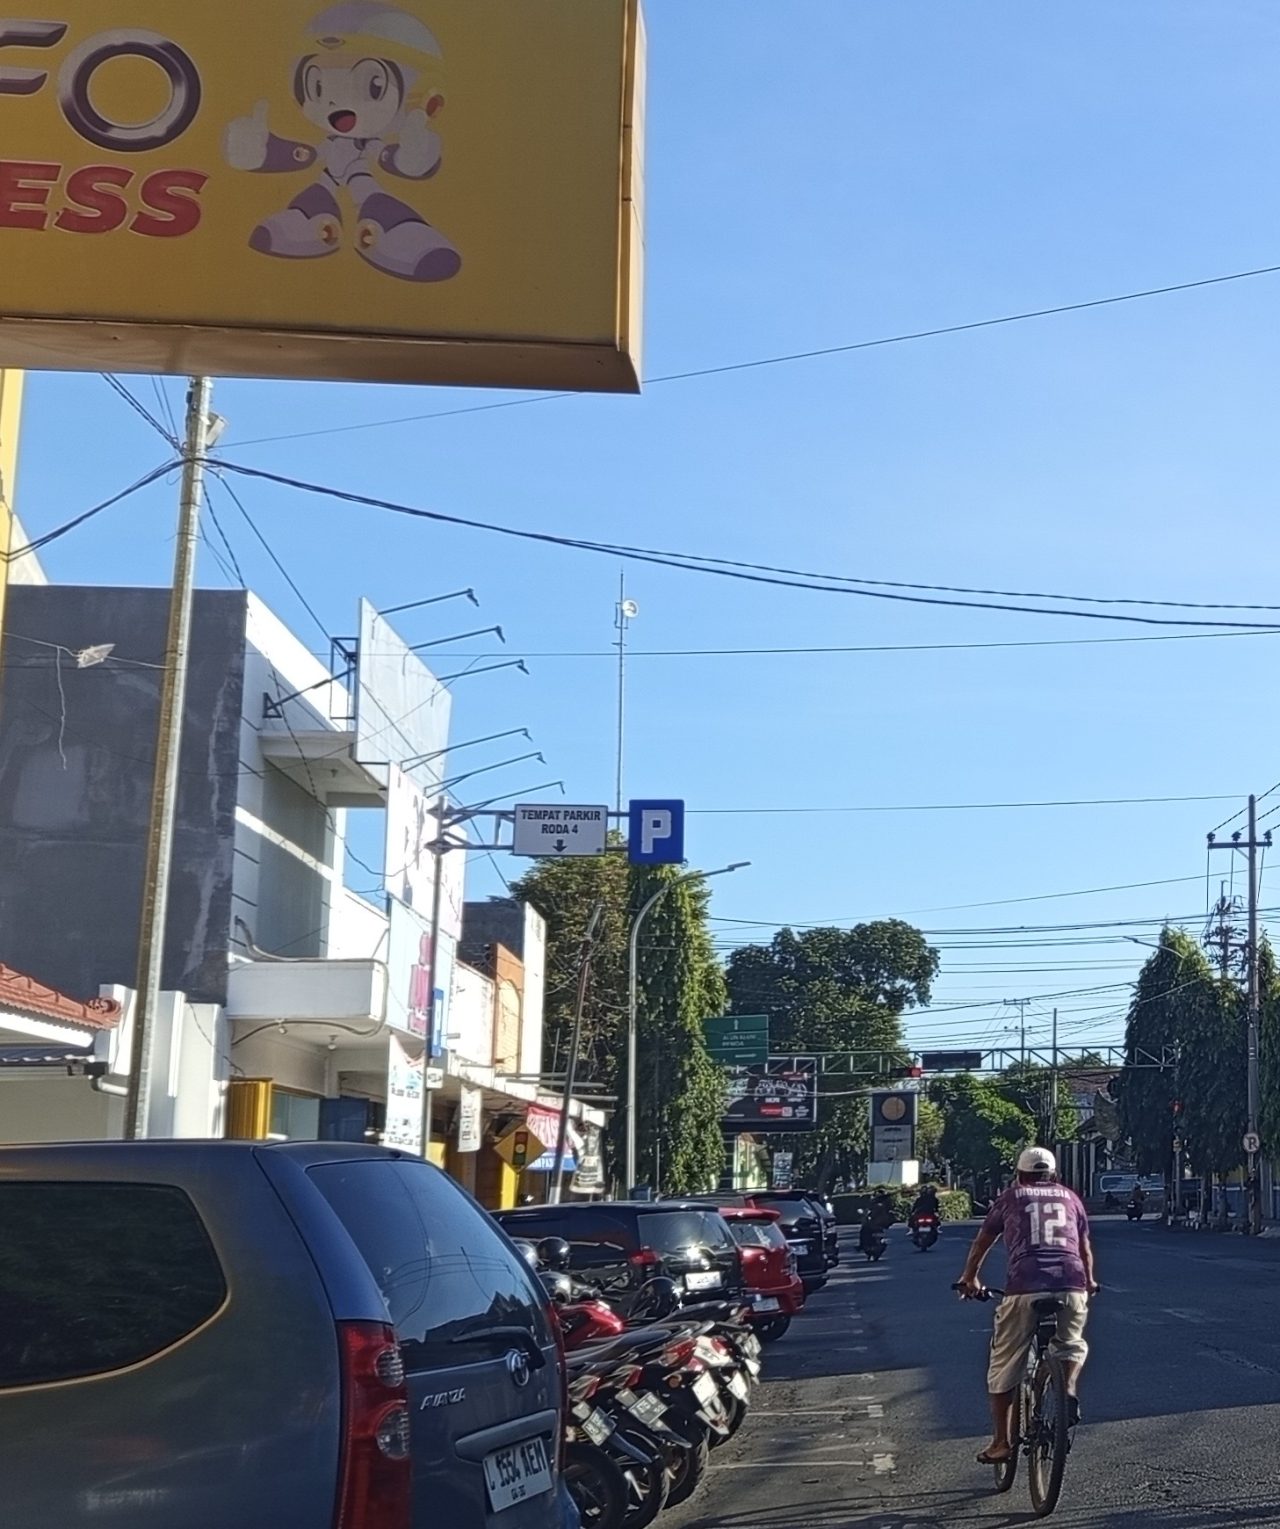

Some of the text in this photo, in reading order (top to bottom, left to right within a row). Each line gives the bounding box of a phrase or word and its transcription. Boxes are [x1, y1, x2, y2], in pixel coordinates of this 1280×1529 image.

[521, 809, 601, 821] TEMPAT PARKIR
[541, 824, 579, 834] RODA 4
[641, 809, 672, 853] P
[1015, 1187, 1072, 1200] INDONESIA
[1024, 1201, 1068, 1247] 12
[520, 1440, 547, 1477] AEM
